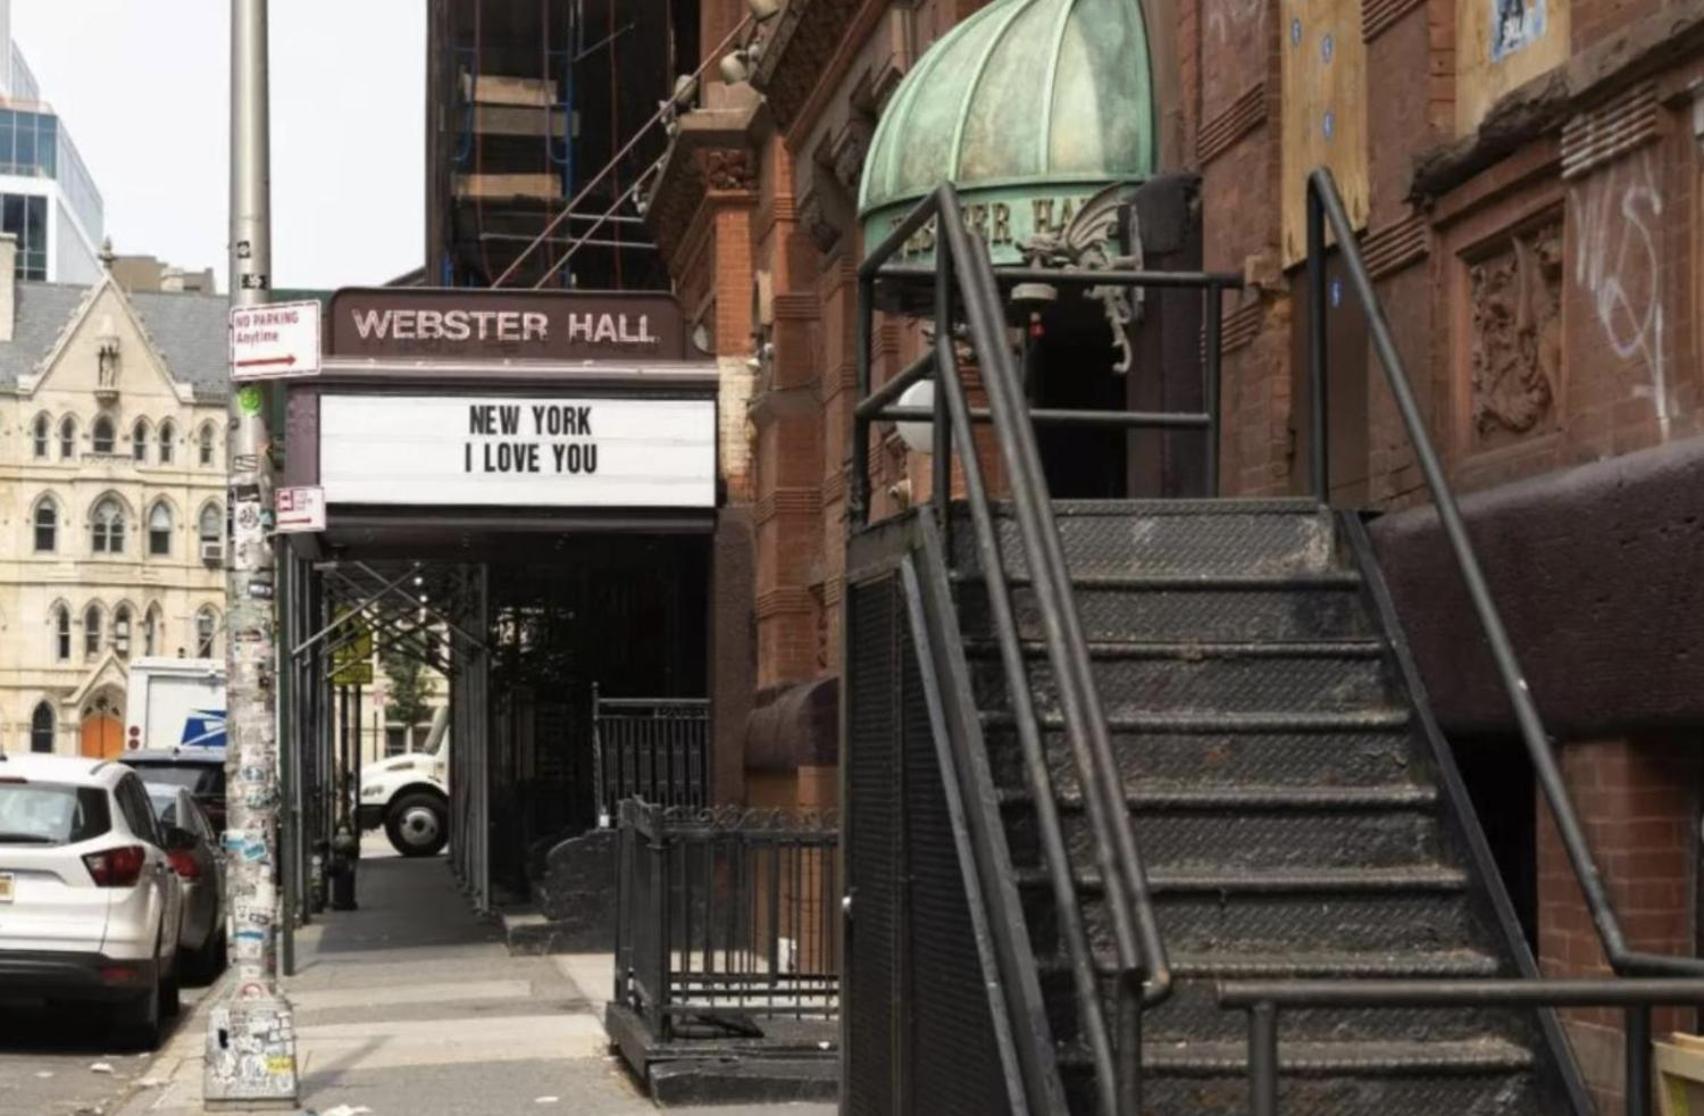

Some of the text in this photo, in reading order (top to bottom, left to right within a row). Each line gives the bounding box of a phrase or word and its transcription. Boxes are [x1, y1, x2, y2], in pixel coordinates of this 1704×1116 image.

[235, 311, 299, 328] NO PARKING
[352, 309, 656, 343] WEBSTER HALL
[236, 331, 279, 347] Anytime
[469, 405, 591, 435] NEW YORK
[465, 442, 597, 473] I LOVE YOU
